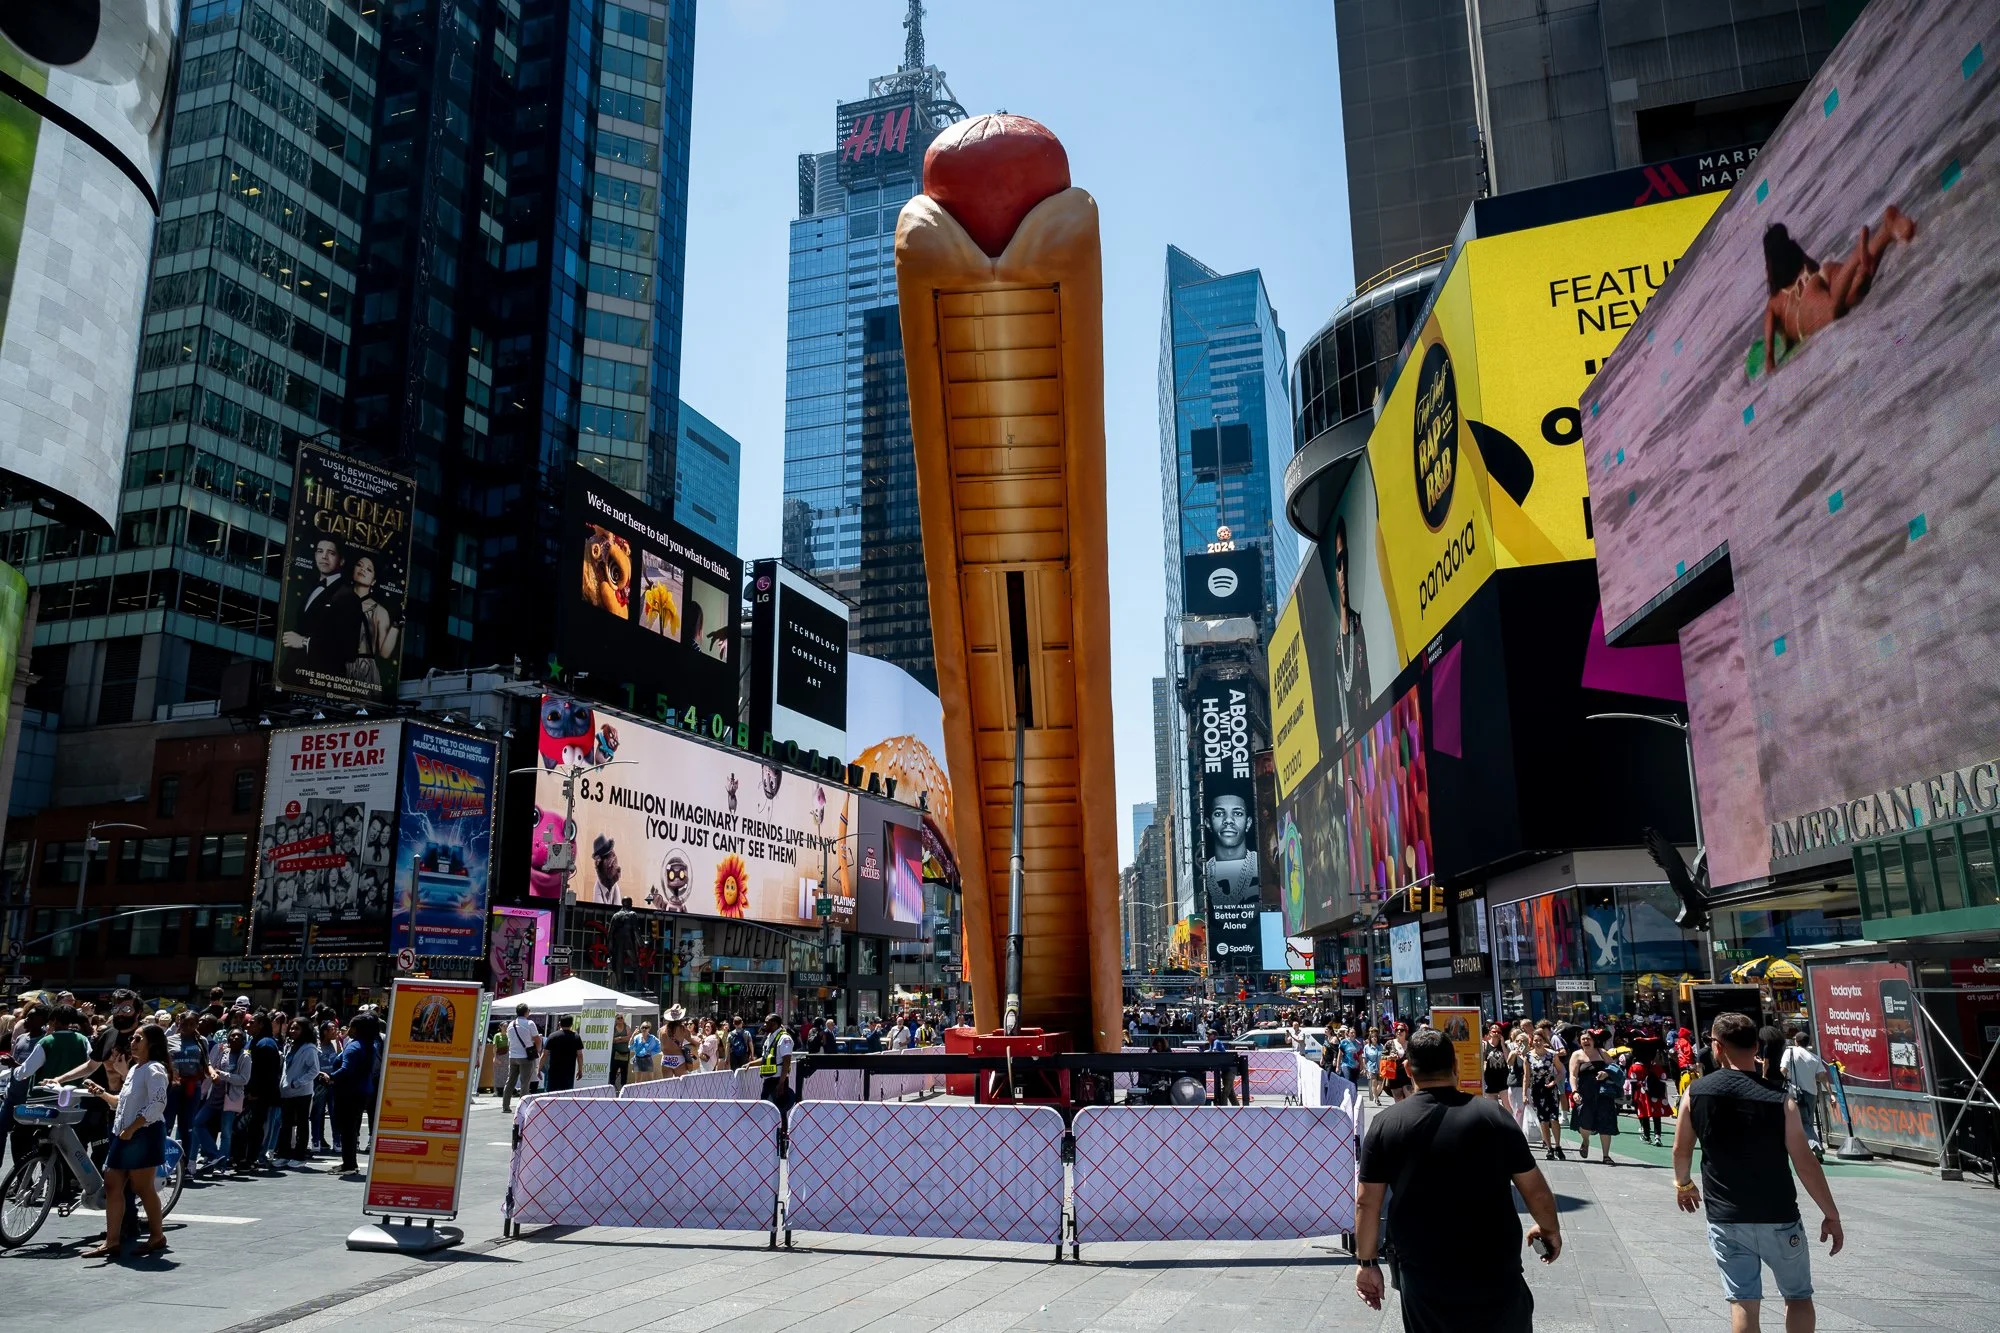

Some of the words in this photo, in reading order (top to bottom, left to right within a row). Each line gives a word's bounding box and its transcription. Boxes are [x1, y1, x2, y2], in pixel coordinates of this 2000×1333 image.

[842, 106, 911, 162] H&M
[1550, 259, 1682, 307] FEATU
[1418, 415, 1442, 479] RAP
[334, 472, 340, 480] &
[348, 467, 398, 491] BEWITCHING
[1425, 446, 1452, 513] R&B
[306, 483, 340, 513] THE
[343, 495, 404, 532] GREAT
[314, 509, 394, 550] GATSBY
[586, 490, 612, 516] We're
[612, 508, 628, 524] not
[628, 514, 646, 535] here
[647, 524, 656, 539] to
[656, 530, 668, 547] tell
[669, 540, 684, 556] you
[684, 546, 702, 566] what
[702, 560, 710, 570] to
[712, 561, 730, 580] think.
[1208, 540, 1235, 553] 2024
[1419, 516, 1476, 620] pandora
[756, 594, 770, 603] LG
[788, 621, 840, 654] TECHNOLOGY
[792, 646, 836, 674] COMPLETES
[316, 672, 353, 685] BROADWAY
[355, 680, 382, 692] THEATRE
[333, 682, 370, 696] BROADWAY
[806, 676, 822, 688] ART
[1219, 711, 1231, 736] WIT
[301, 732, 350, 752] BEST
[354, 728, 380, 748] OF
[435, 736, 448, 747] TIME
[450, 740, 458, 748] TO
[459, 742, 482, 754] CHANGE
[1202, 698, 1222, 773] HOODIE
[290, 752, 327, 771] THE
[331, 748, 385, 768] YEAR!
[413, 740, 439, 752] MUSICAL
[440, 746, 466, 758] THEATER
[466, 753, 490, 764] HISTORY
[1220, 740, 1232, 760] DA
[413, 752, 478, 791] BACK
[433, 787, 486, 809] FUTURE
[462, 808, 483, 817] MUSICAL
[580, 778, 604, 802] 8.3
[609, 785, 666, 817] MILLION
[670, 800, 738, 833] IMAGINARY
[742, 817, 782, 842] FRIENDS
[785, 828, 804, 848] LIVE
[806, 832, 817, 850] IN
[1770, 783, 1916, 861] AMERICAN
[646, 816, 678, 842] (YOU
[682, 825, 710, 849] JUST
[712, 833, 745, 854] CAN'T
[748, 841, 764, 859] SEE
[768, 844, 797, 868] THEM)
[312, 857, 342, 866] ALONG
[834, 894, 856, 908] PLAYING
[1459, 888, 1474, 899] SEPHORA
[1214, 912, 1239, 920] Better
[724, 923, 790, 958] FOREVER
[1229, 944, 1255, 953] Spotify
[1453, 956, 1481, 974] SEPHORA
[808, 974, 819, 982] POLO
[740, 984, 768, 997] FOREVER
[582, 1008, 615, 1018] COLLECTION
[1829, 1008, 1870, 1023] Broadway's
[585, 1024, 608, 1034] DRIVE
[1826, 1023, 1840, 1034] best
[1840, 1024, 1850, 1035] tix
[1851, 1026, 1860, 1037] at
[1860, 1028, 1876, 1042] your
[1834, 1038, 1872, 1055] fingertips.
